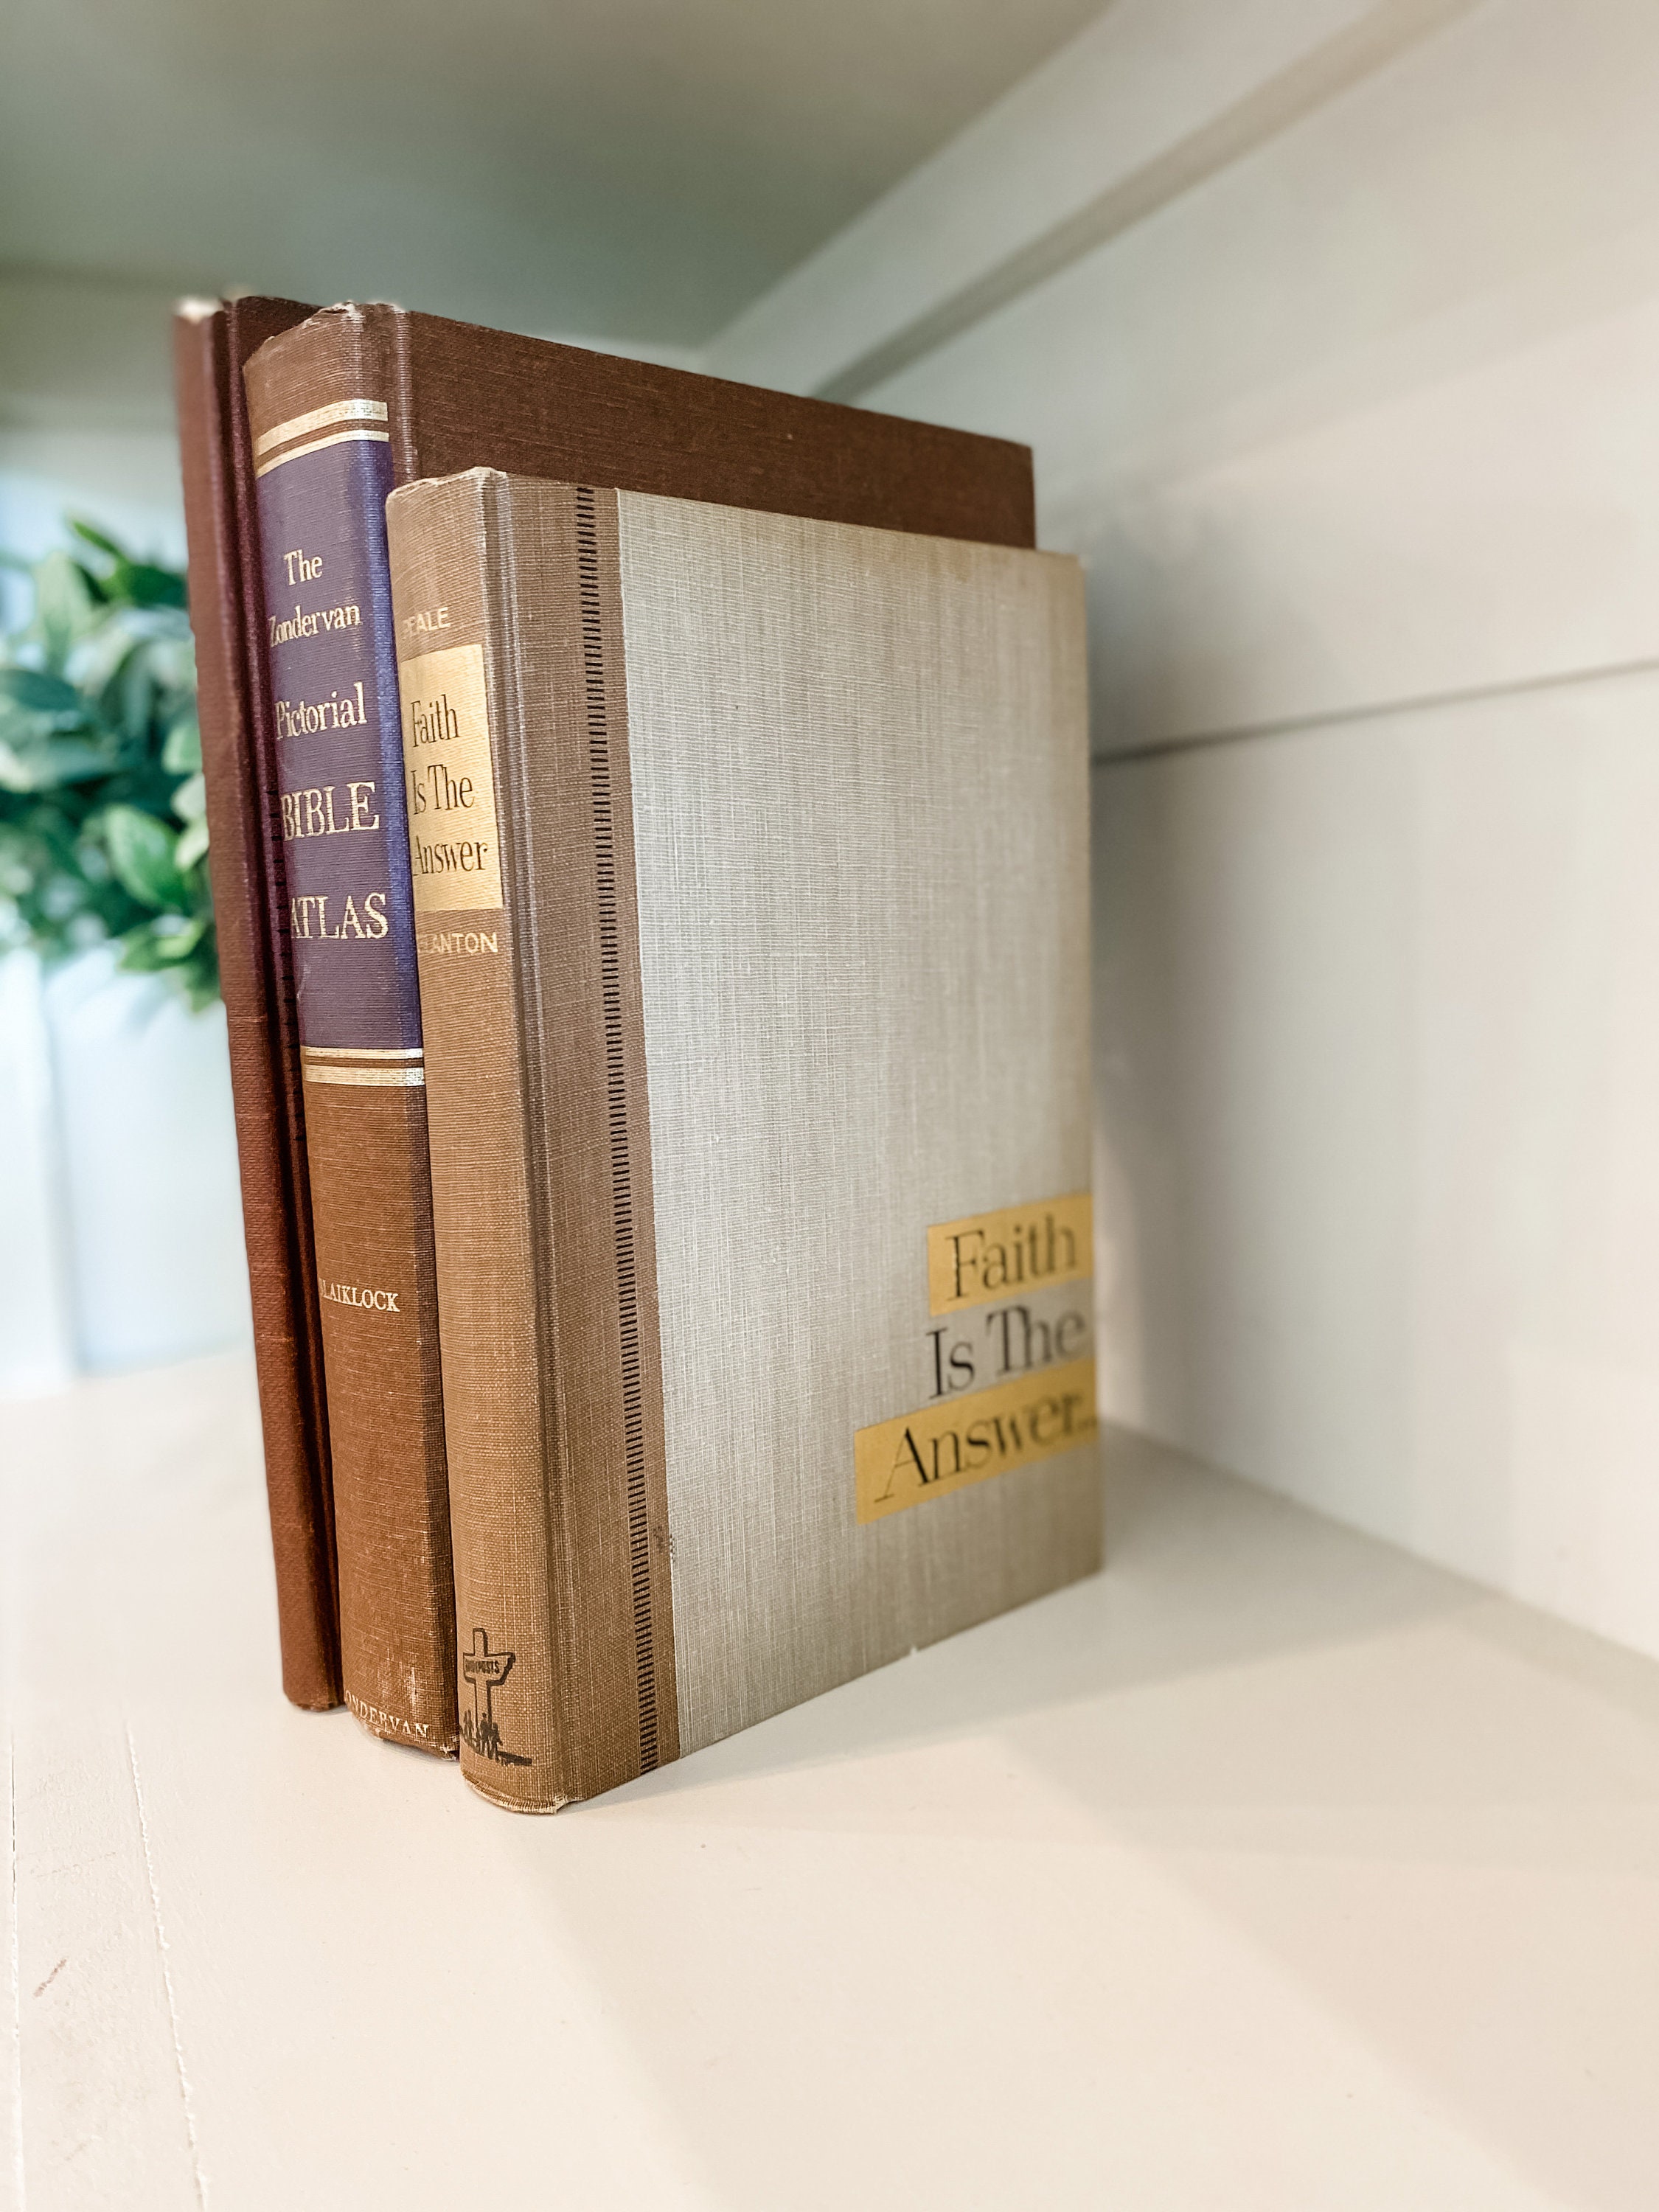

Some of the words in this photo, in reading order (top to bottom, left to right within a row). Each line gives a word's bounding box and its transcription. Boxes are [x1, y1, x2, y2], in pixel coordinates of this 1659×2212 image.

[283, 549, 323, 585] The
[268, 605, 364, 648] Zondervan
[274, 681, 368, 740] Pictorial
[411, 694, 460, 748] Faith
[281, 781, 380, 842] BIBLE
[411, 770, 427, 815] Is
[428, 763, 475, 810] The
[413, 835, 488, 876] Answer
[291, 891, 389, 939] ATLAS
[945, 1212, 1076, 1302] Faith
[319, 1277, 400, 1312] LAIKLOCK
[926, 1326, 975, 1399] Is
[984, 1304, 1086, 1377] The
[344, 1689, 430, 1739] ONDERVAN
